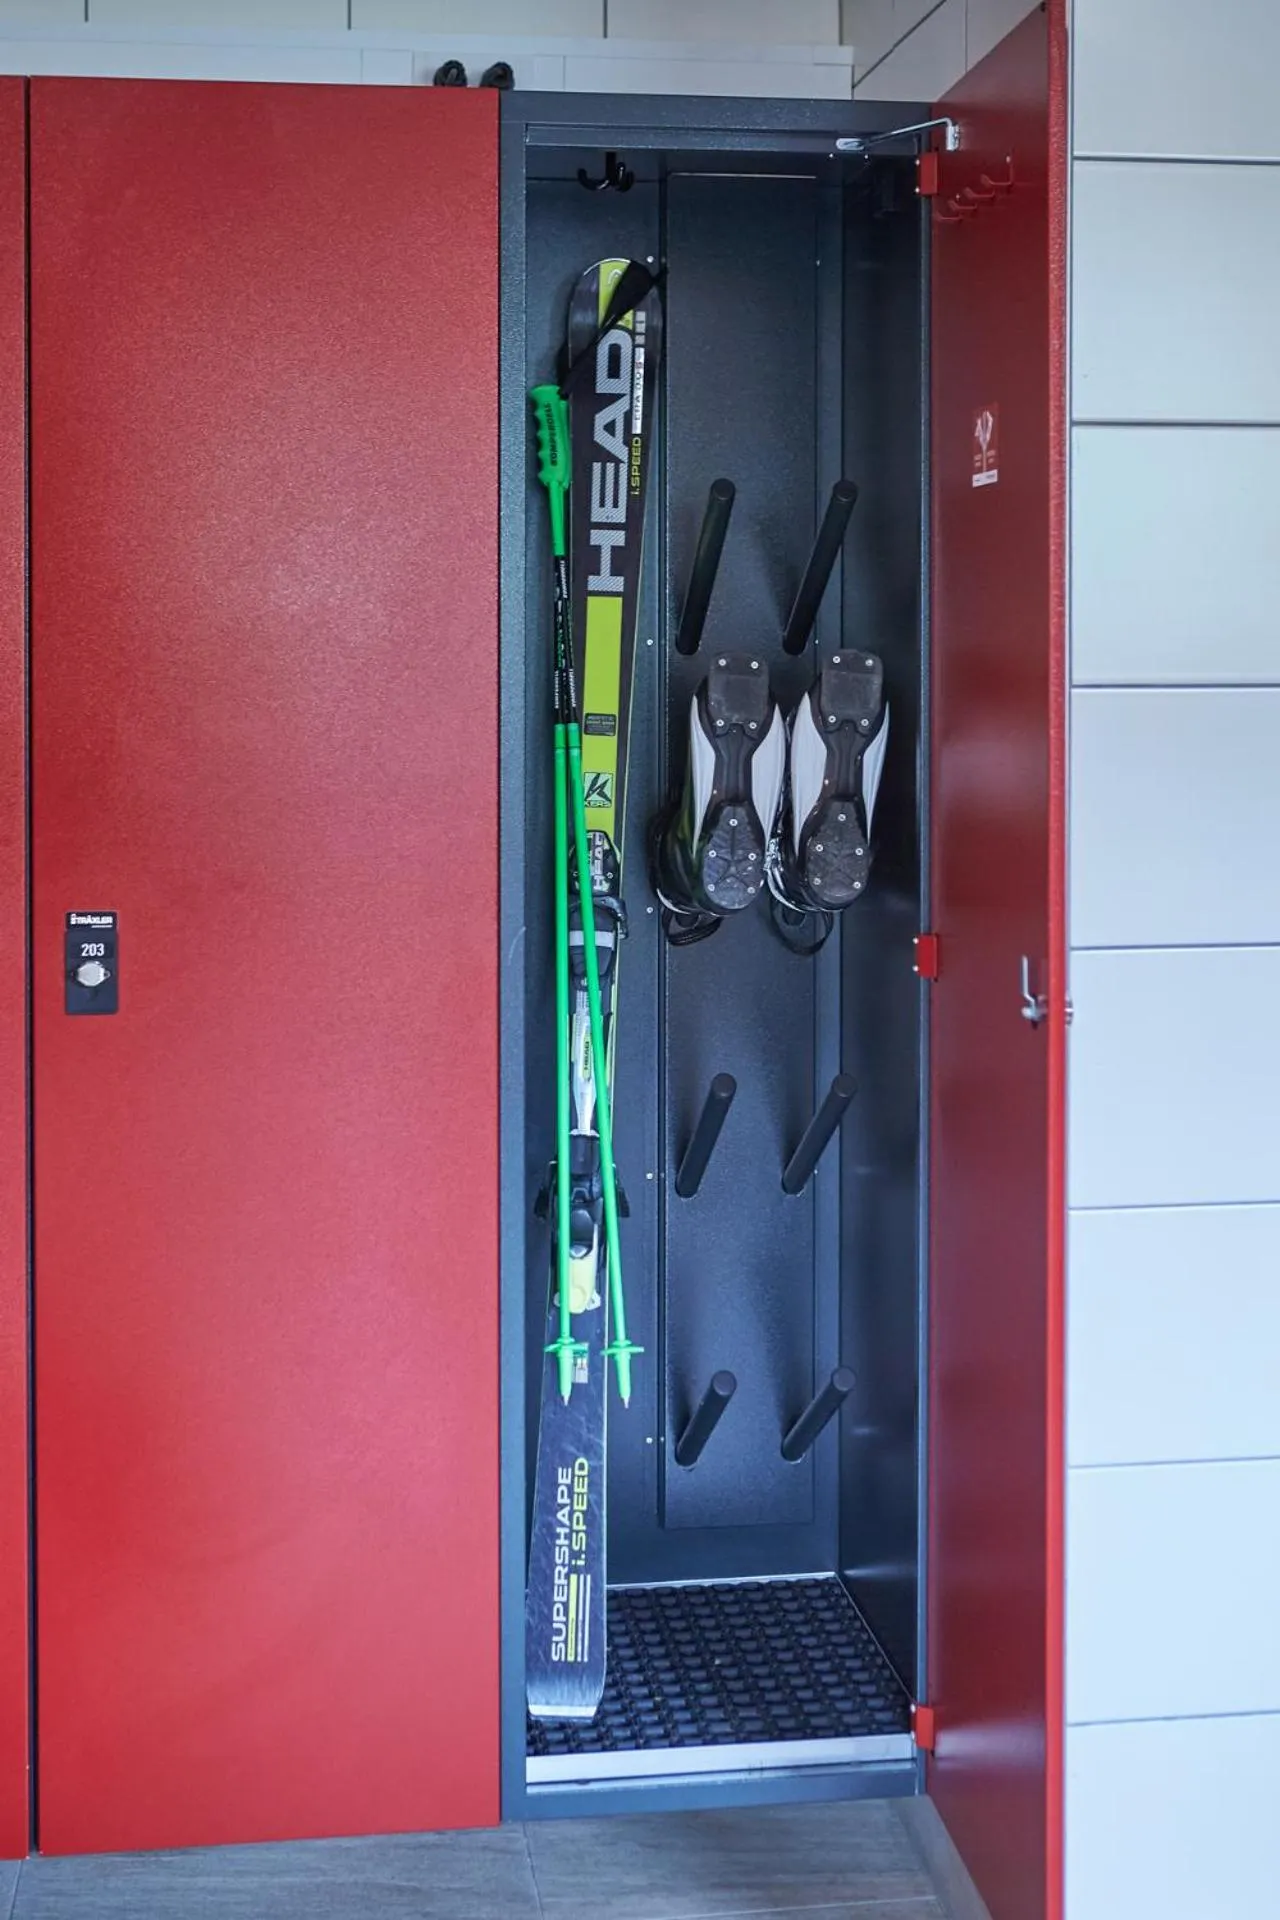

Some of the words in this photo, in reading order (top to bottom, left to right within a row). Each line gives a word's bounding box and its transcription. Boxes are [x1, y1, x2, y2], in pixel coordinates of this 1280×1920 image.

[587, 329, 632, 592] HEAD
[631, 437, 642, 495] i.SPEED
[81, 943, 105, 957] 203
[552, 1467, 572, 1662] SUPERSHAPE
[572, 1457, 589, 1566] i.SPEED
